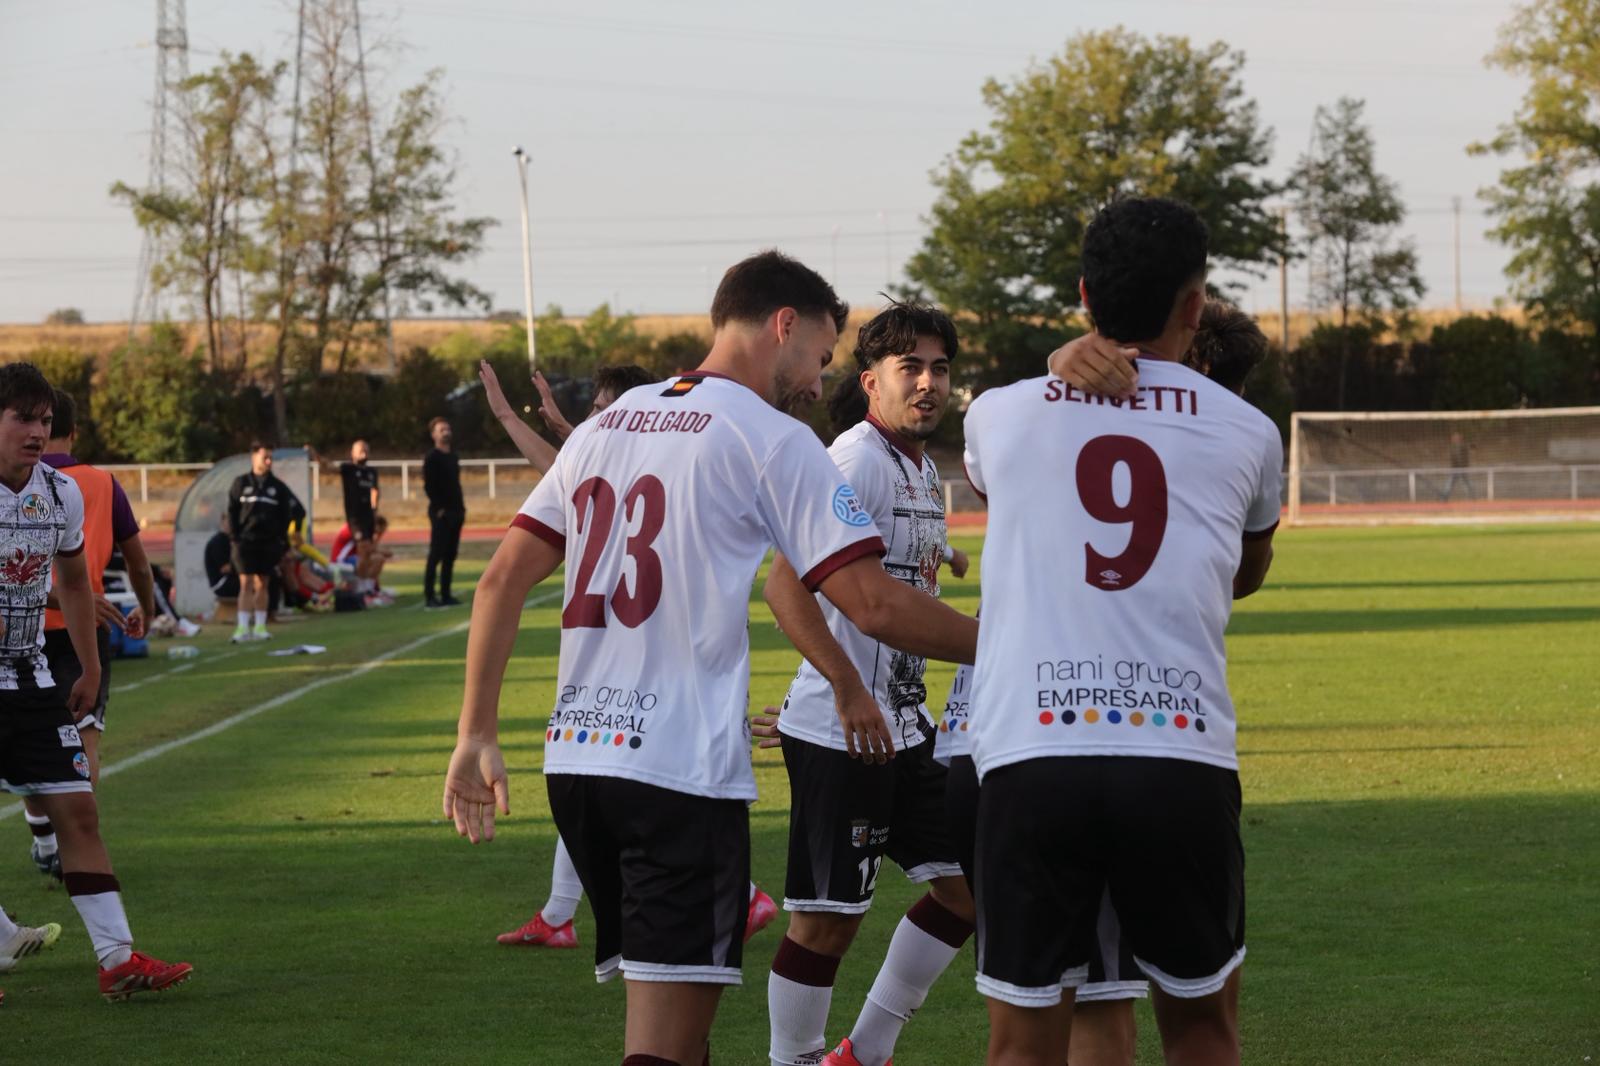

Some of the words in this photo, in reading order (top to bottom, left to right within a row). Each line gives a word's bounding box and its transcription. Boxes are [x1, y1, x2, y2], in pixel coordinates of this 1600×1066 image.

[593, 409, 628, 432] AVI
[626, 410, 712, 433] DELGADO
[1075, 434, 1168, 591] 9
[562, 474, 666, 628] 23
[1037, 654, 1103, 682] nani
[1114, 660, 1202, 692] grupo
[1038, 688, 1207, 716] EMPRESARIAL
